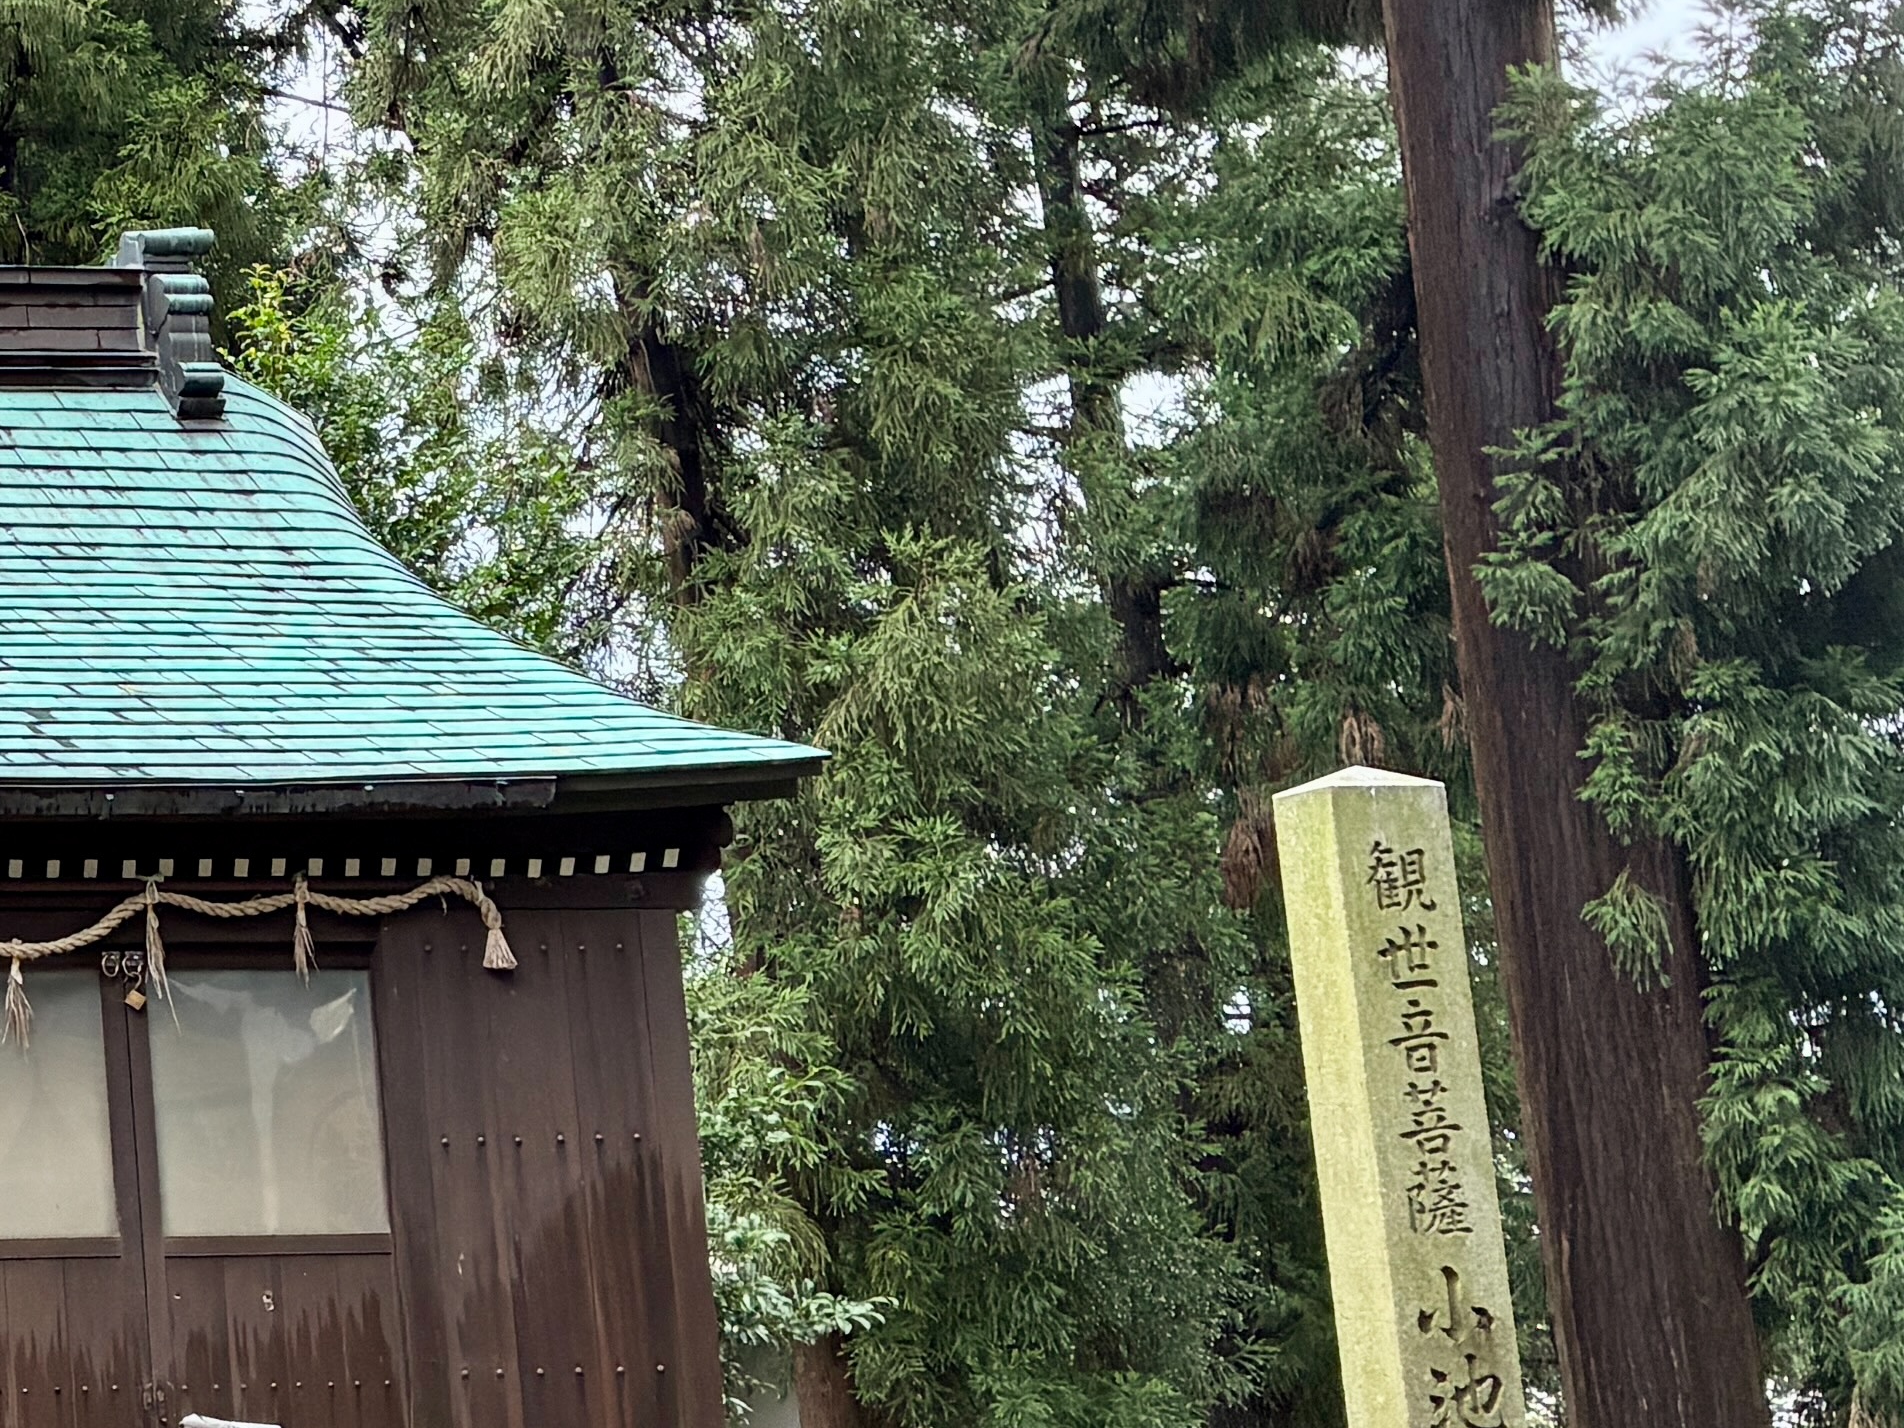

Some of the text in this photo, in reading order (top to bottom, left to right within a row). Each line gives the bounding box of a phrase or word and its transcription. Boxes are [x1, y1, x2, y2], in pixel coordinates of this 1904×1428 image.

[1367, 840, 1474, 1236] 観世音菩薩
